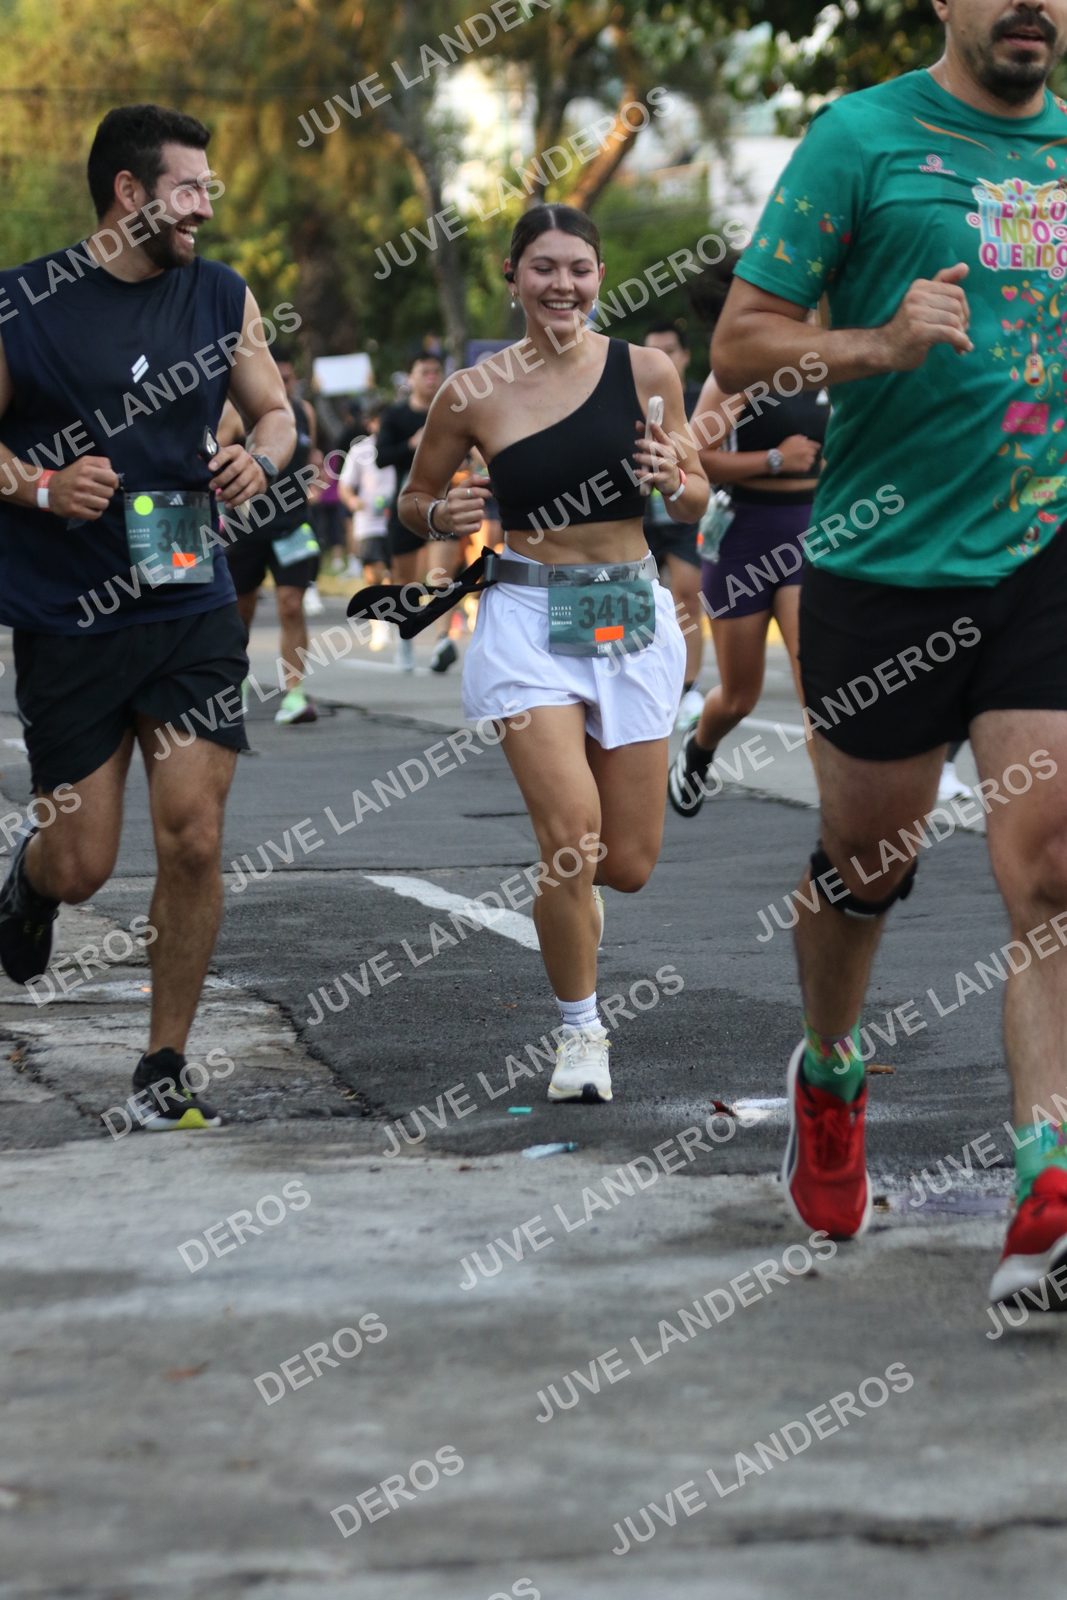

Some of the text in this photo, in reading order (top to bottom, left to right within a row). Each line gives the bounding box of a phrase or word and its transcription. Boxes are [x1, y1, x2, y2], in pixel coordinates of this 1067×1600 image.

[982, 217, 1050, 244] LINDO
[981, 242, 1067, 268] QUERIDO
[156, 518, 210, 552] 341
[578, 590, 651, 629] 3413
